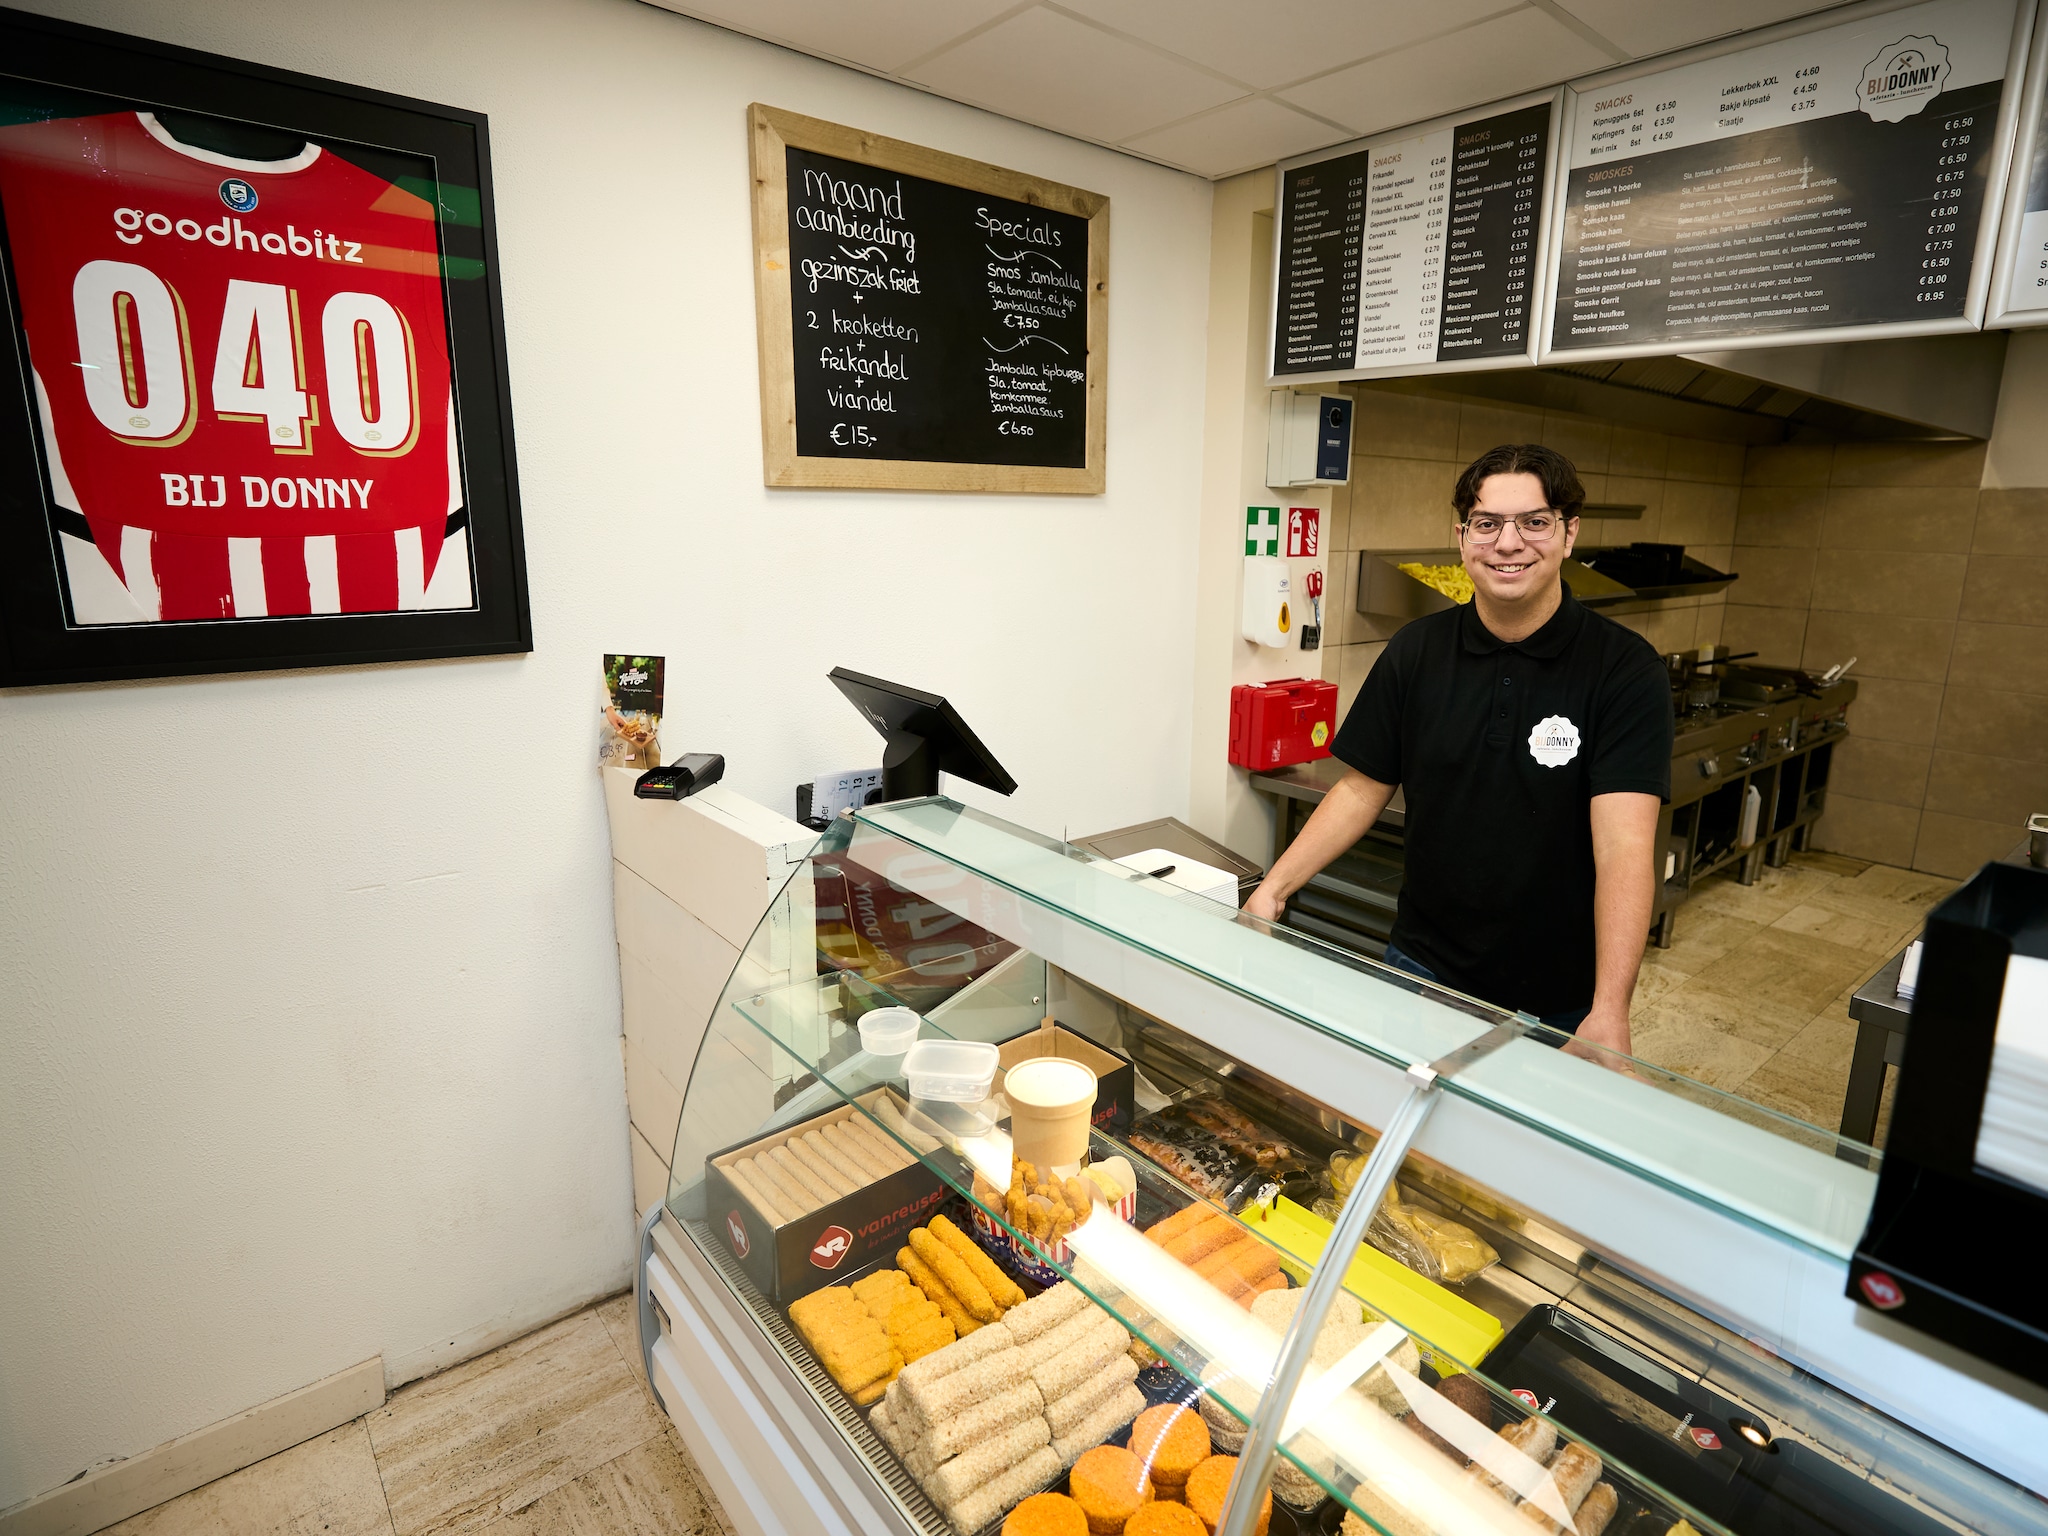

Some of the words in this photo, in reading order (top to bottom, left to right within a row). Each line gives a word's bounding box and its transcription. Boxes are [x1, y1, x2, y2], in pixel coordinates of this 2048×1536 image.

[1867, 64, 1940, 95] BIJDONNY
[1722, 80, 1761, 96] Lekkerbek
[1762, 76, 1779, 86] XXL
[1594, 94, 1633, 112] SNACKS
[1720, 102, 1741, 112] Bakje
[1743, 94, 1771, 107] kipsaté
[1800, 82, 1818, 94] 4.50
[1593, 113, 1630, 127] Kipnuggets
[1633, 109, 1644, 118] 6st
[1662, 100, 1677, 111] 3.50
[1718, 116, 1744, 128] Slaatje
[1798, 100, 1816, 110] 3.75
[1592, 128, 1625, 141] Kipfingers
[1632, 124, 1642, 132] 6st
[1660, 116, 1675, 126] 3.50
[1953, 117, 1973, 129] 6.50
[1459, 130, 1491, 146] SNACKS
[1590, 146, 1604, 156] Mini
[1605, 144, 1618, 153] mix
[1630, 139, 1641, 147] 8st
[1658, 131, 1674, 140] 4.50
[1950, 135, 1970, 146] 7.50
[1374, 154, 1402, 168] SNACKS
[1947, 153, 1967, 164] 6.50
[1372, 169, 1394, 180] Frikandel
[1588, 166, 1634, 182] SMOSKES
[1944, 170, 1964, 182] 6.75
[1372, 182, 1394, 192] Frikandel
[1394, 176, 1414, 188] speciaal
[1586, 187, 1611, 198] Smoske
[1618, 182, 1642, 192] boerke
[1372, 194, 1393, 204] Frikandel
[1394, 192, 1403, 200] XXL
[1942, 188, 1961, 200] 7.50
[1584, 202, 1610, 212] Smoske
[1938, 206, 1958, 216] 8.00
[975, 208, 1062, 246] Specials
[1582, 216, 1608, 226] Somske
[796, 205, 915, 263] aanbieding
[1936, 223, 1956, 234] 7.00
[113, 206, 364, 264] goodhabitz
[1581, 230, 1606, 240] Smoske
[1580, 244, 1605, 254] Smoske
[1606, 240, 1630, 251] gezond
[1933, 240, 1953, 250] 7.75
[1450, 253, 1472, 262] Kipcorn
[1472, 250, 1484, 258] XXL
[1578, 258, 1604, 267] Smoske
[1605, 256, 1620, 264] kaas
[1628, 252, 1642, 260] ham
[1644, 249, 1667, 258] deluxe
[1450, 263, 1486, 274] Chickenstrips
[1930, 257, 1950, 268] 6.50
[801, 256, 888, 293] gezinszak
[1027, 266, 1082, 292] jamballa
[1576, 272, 1602, 280] Smoske
[1603, 269, 1620, 278] oude
[1621, 267, 1636, 275] kaas
[1928, 274, 1947, 284] 8.00
[1575, 285, 1600, 294] Smoske
[1602, 282, 1626, 293] gezond
[1626, 280, 1644, 288] oude
[1645, 278, 1661, 286] kaas
[1448, 288, 1478, 299] Shoarmarol
[1924, 291, 1944, 301] 8.95
[1446, 302, 1472, 312] Mexicano
[1574, 299, 1600, 308] Smoske
[1601, 296, 1620, 304] Gerrit
[806, 310, 820, 330] 2
[1446, 315, 1470, 324] Mexicano
[1471, 310, 1500, 322] gepaneerd
[1572, 312, 1598, 322] Smoske
[1444, 326, 1472, 336] Knakworst
[1571, 326, 1596, 334] Smoske
[1598, 322, 1629, 332] carpaccio
[1443, 338, 1472, 348] Bitterballen
[73, 260, 421, 458] 040
[160, 473, 226, 508] BIJ
[240, 476, 374, 510] DONNY
[839, 780, 848, 792] 12
[853, 777, 862, 789] 13
[867, 776, 876, 787] 14
[858, 1185, 943, 1238] vanreusel
